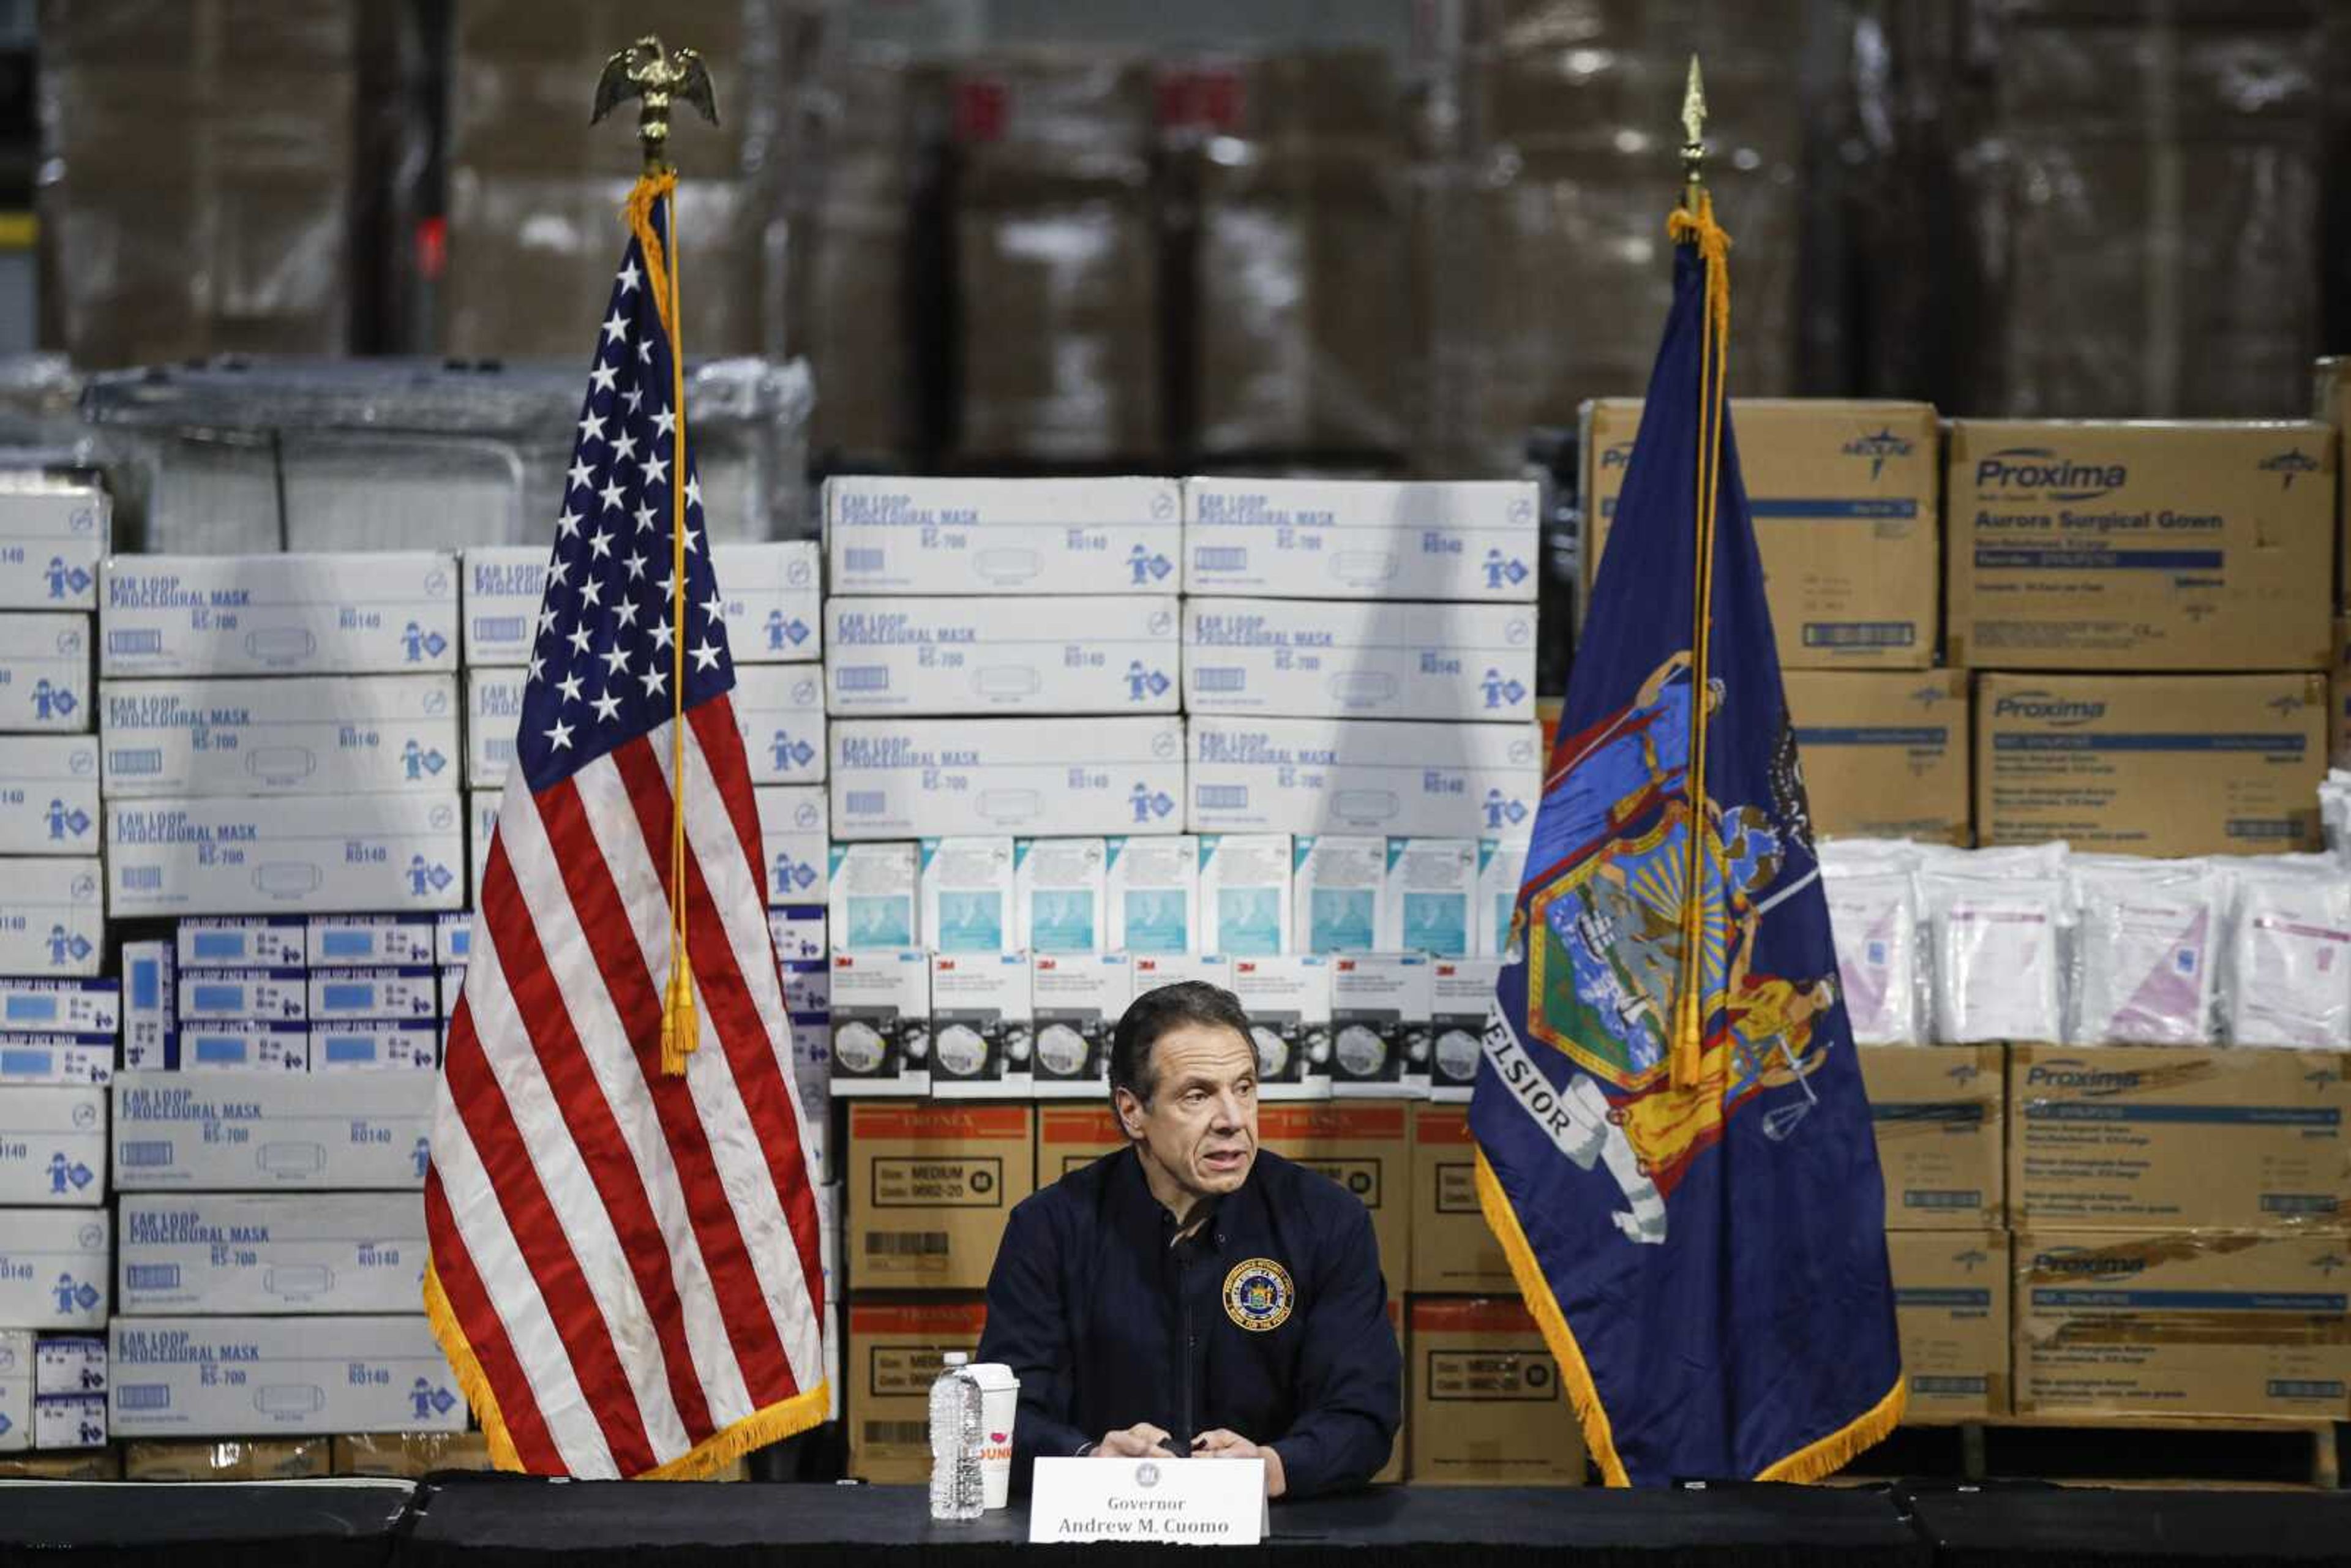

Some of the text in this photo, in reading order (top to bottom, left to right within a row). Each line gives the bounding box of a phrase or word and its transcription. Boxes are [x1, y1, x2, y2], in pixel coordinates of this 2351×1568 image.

[1976, 458, 2128, 487] Proxima
[1975, 510, 2224, 533] Aurora Surgical Gown
[110, 577, 179, 591] EAR LOOP
[210, 590, 248, 606] MASK
[110, 698, 179, 711] EAR LOOP
[1993, 696, 2106, 719] Proxima
[210, 710, 248, 726] MASK
[118, 812, 187, 826] EAR LOOP
[217, 826, 256, 841] MASK
[835, 956, 853, 968] 3M
[937, 959, 955, 970] 3M
[1037, 959, 1056, 970] 3M
[1137, 959, 1155, 970] 3M
[1237, 963, 1256, 972] 3M
[1337, 960, 1355, 971] 3M
[1436, 965, 1455, 977] 3M
[2026, 1065, 2141, 1087] Proxima
[123, 1089, 192, 1103] EAR LOOP
[222, 1104, 261, 1119] MASK
[912, 1167, 963, 1180] MEDIUM
[130, 1212, 199, 1226] EAR LOOP
[229, 1226, 268, 1242] MASK
[2031, 1254, 2147, 1274] Proxima
[119, 1332, 189, 1346] EAR LOOP
[219, 1346, 258, 1362] MASK
[1108, 1497, 1187, 1510] Governor
[1059, 1518, 1229, 1533] Andrew M. Cuomo
